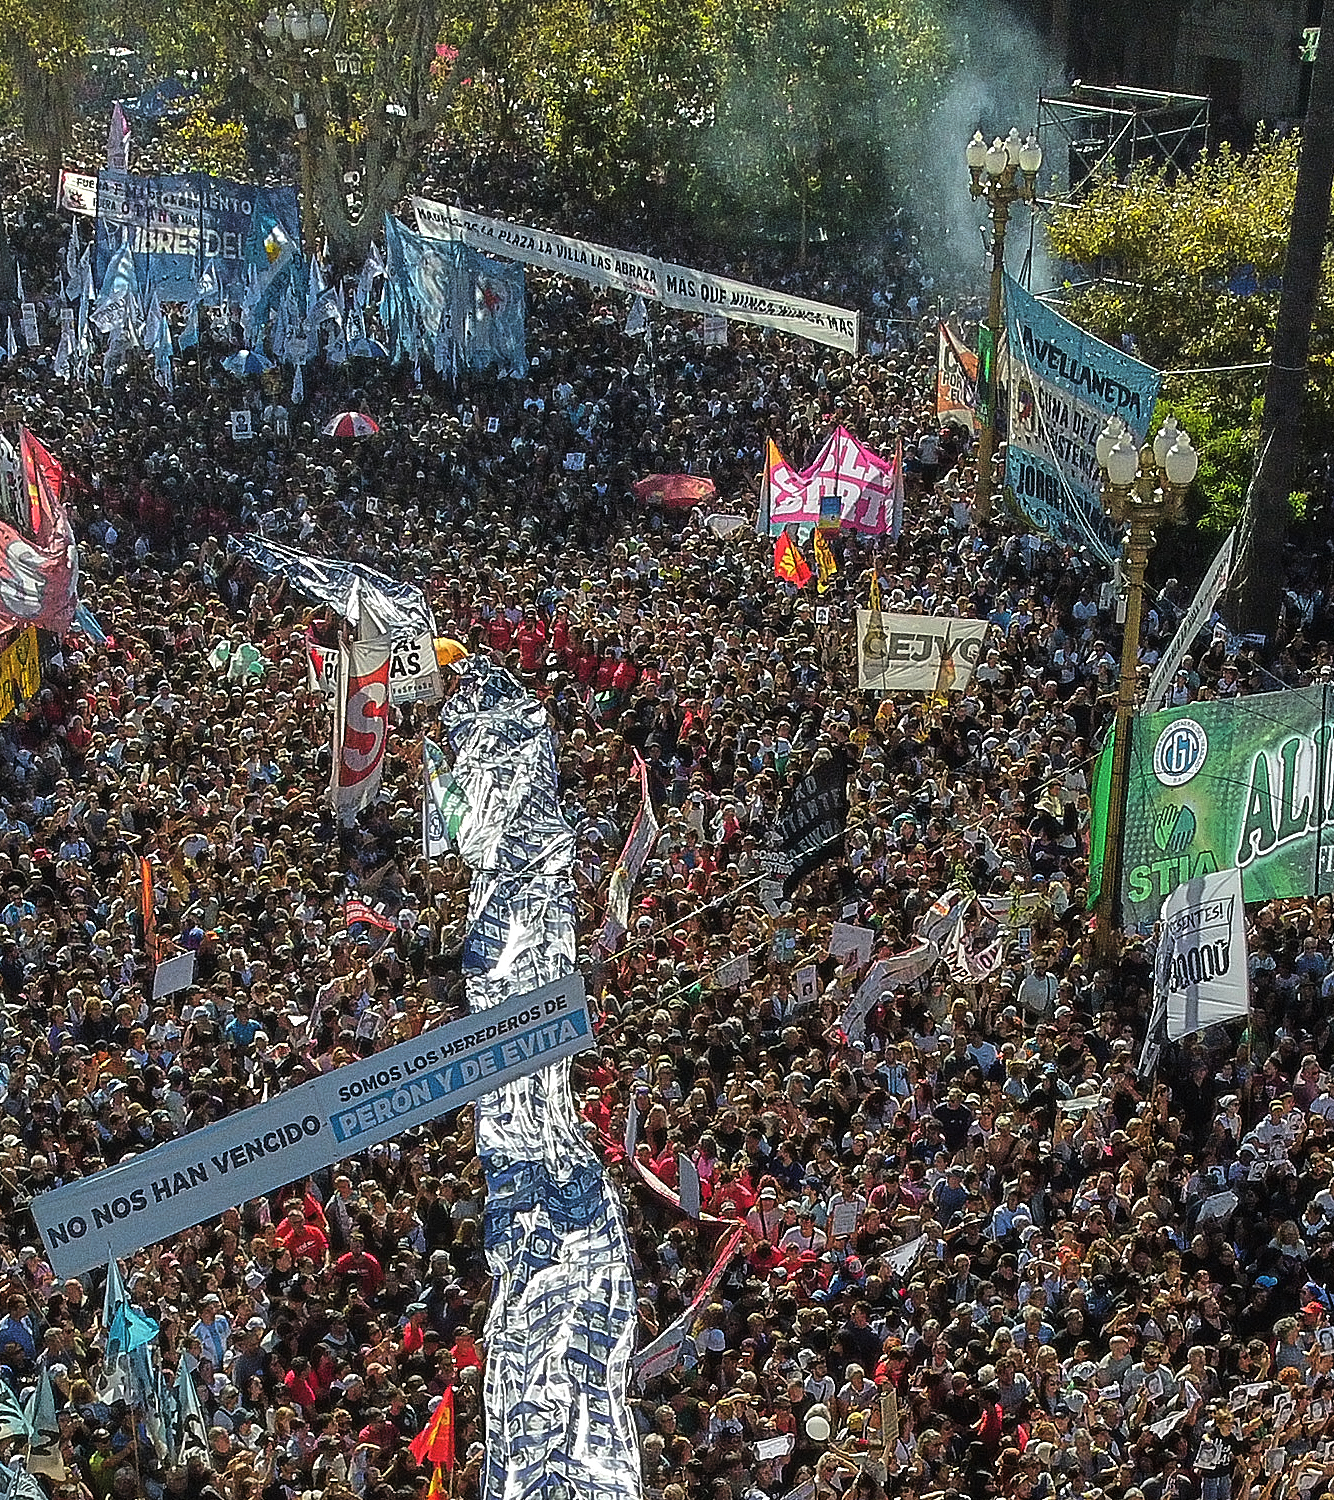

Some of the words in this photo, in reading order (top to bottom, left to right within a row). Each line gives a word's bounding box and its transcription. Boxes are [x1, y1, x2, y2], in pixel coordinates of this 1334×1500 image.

[498, 229, 535, 251] PLAZA
[537, 240, 554, 256] LA
[556, 244, 589, 265] VILLA
[590, 252, 612, 271] LAS
[613, 260, 658, 284] ABRAZA
[700, 283, 728, 306] QUE
[1023, 325, 1142, 420] AVELLANEDA
[338, 1064, 400, 1103] SOMOS
[402, 1051, 440, 1078] LOS
[441, 1006, 540, 1063] HEREDEROS
[542, 993, 568, 1015] DE
[434, 1071, 458, 1100] Y
[460, 1050, 501, 1088] DE
[502, 1020, 580, 1070] EVITA
[47, 1216, 88, 1250] NO
[91, 1189, 149, 1232] NOS
[153, 1161, 209, 1211] HAN
[211, 1111, 323, 1176] VENCIDO
